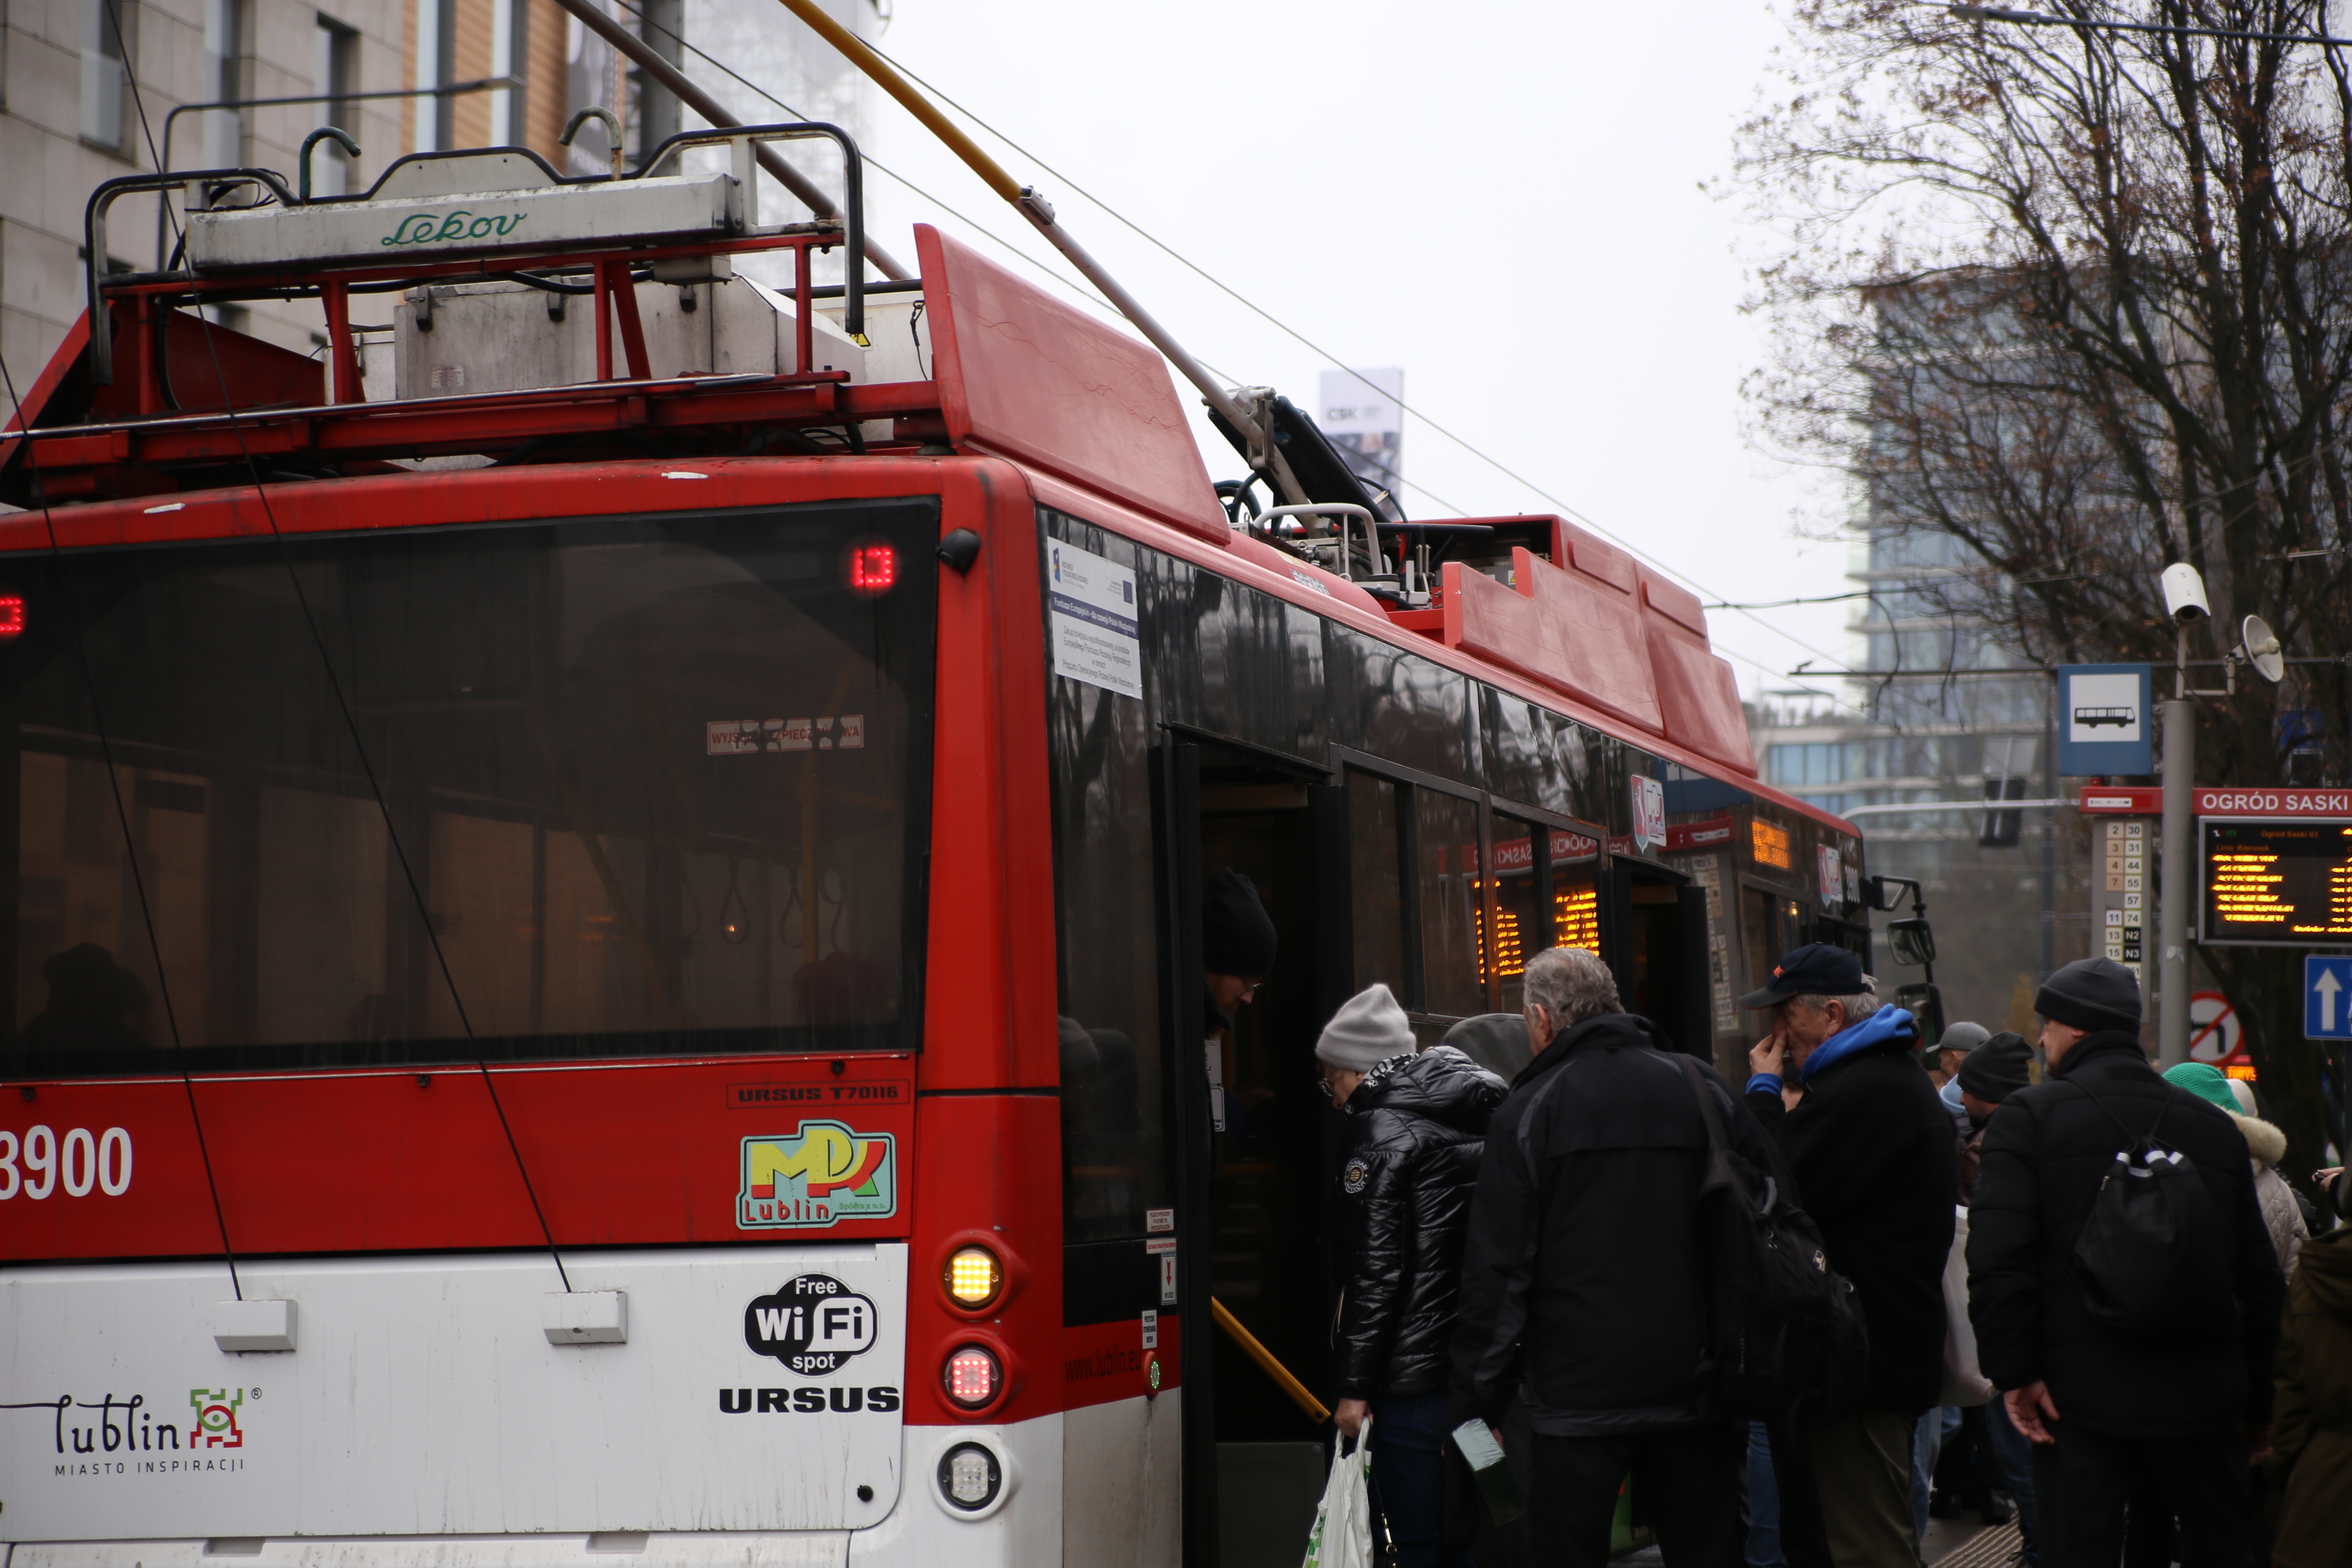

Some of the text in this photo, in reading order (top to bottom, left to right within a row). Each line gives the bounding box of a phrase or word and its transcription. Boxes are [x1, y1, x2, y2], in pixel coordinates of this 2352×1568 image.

[380, 210, 528, 245] Lekov
[2202, 791, 2348, 811] OGRÓD SASKI
[2113, 826, 2118, 835] 2
[2128, 826, 2140, 835] 30
[2261, 830, 2285, 839] Ogród
[2113, 843, 2118, 852] 3
[2128, 843, 2139, 852] 31
[2112, 861, 2118, 870] 4
[2127, 861, 2139, 870] 44
[2112, 878, 2118, 886] 7
[2127, 879, 2139, 888] 55
[2127, 896, 2139, 905] 57
[2109, 914, 2119, 922] 11
[2127, 914, 2138, 922] 74
[2108, 931, 2120, 940] 13
[2126, 931, 2139, 940] N2
[2108, 948, 2120, 957] 15
[2126, 949, 2140, 958] N3
[738, 1085, 898, 1102] URSUS T70116
[0, 1124, 133, 1200] 3900
[745, 1198, 829, 1222] Lublin
[839, 1202, 864, 1211] Spółka
[795, 1278, 837, 1295] Free
[793, 1353, 835, 1372] spot
[1065, 1344, 1142, 1383] www.lublin.eu
[720, 1387, 900, 1413] URSUS
[55, 1458, 244, 1476] MIASTO INSPIRACJI
